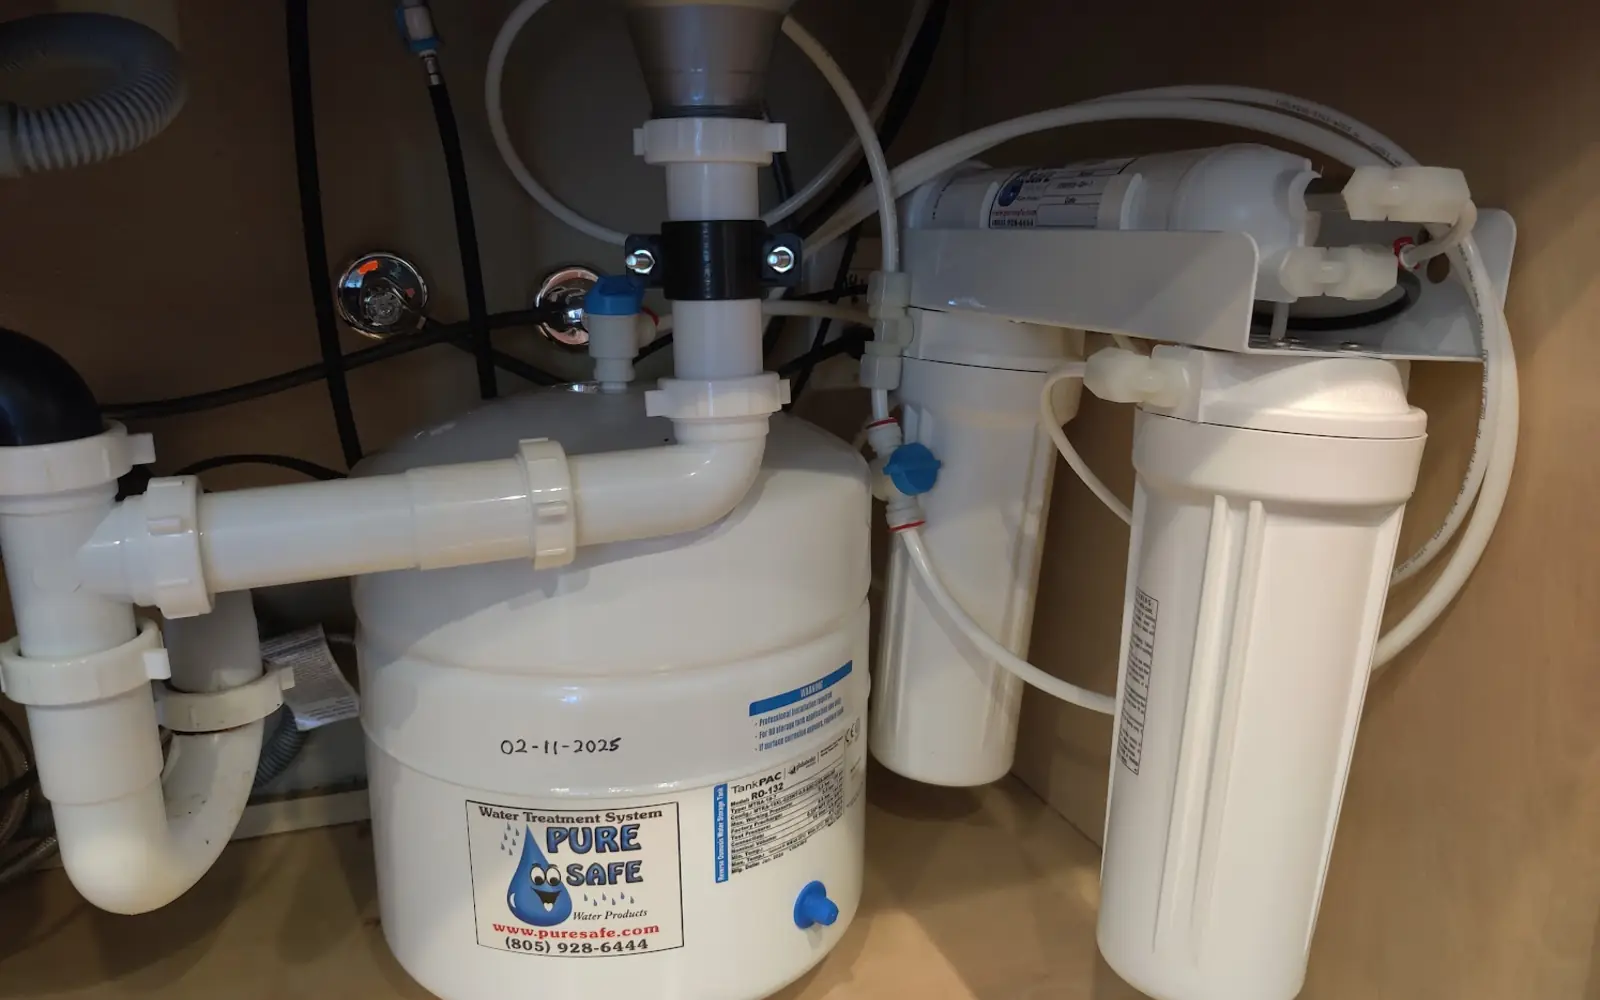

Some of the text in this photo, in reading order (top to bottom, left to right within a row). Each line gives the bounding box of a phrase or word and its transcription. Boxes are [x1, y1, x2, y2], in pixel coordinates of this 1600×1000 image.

[500, 737, 622, 755] 02-11-2025
[731, 772, 782, 794] TankPAC
[751, 782, 784, 800] RO-132
[478, 806, 663, 825] Water Treatment System
[546, 823, 642, 854] PURE
[566, 860, 643, 886] SAFE
[573, 908, 648, 921] Water Products
[492, 922, 660, 939] www.puresafe.com
[505, 937, 649, 954] (805) 928-6444
